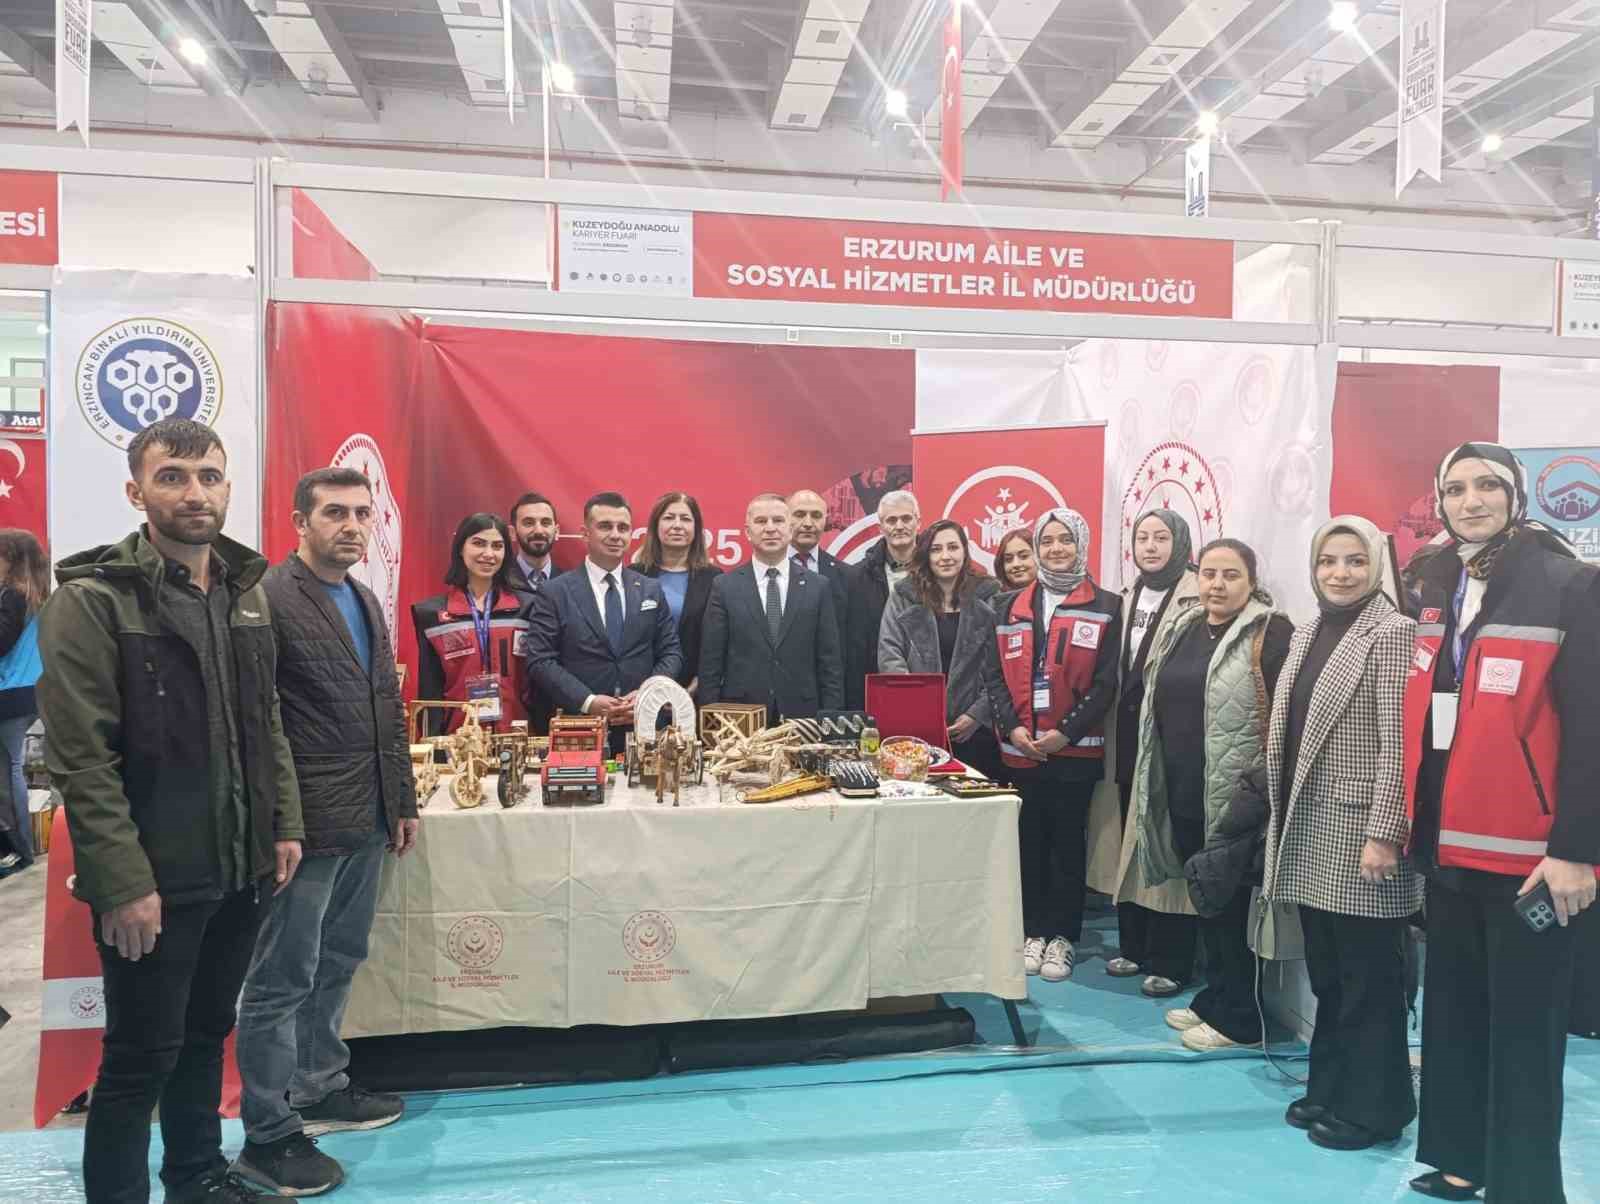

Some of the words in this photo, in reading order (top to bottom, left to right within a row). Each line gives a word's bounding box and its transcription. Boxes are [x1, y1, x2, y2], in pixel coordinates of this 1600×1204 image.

[634, 223, 680, 233] ANADOLU
[843, 237, 975, 264] ERZURUM
[983, 240, 1043, 267] AİLE
[1049, 247, 1084, 269] VE
[727, 264, 836, 290] SOSYAL
[843, 267, 995, 297] HİZMETLER
[1002, 271, 1027, 298] İL
[1033, 275, 1196, 305] MÜDÜRLÜĞÜ
[132, 325, 194, 349] YILDIRIM
